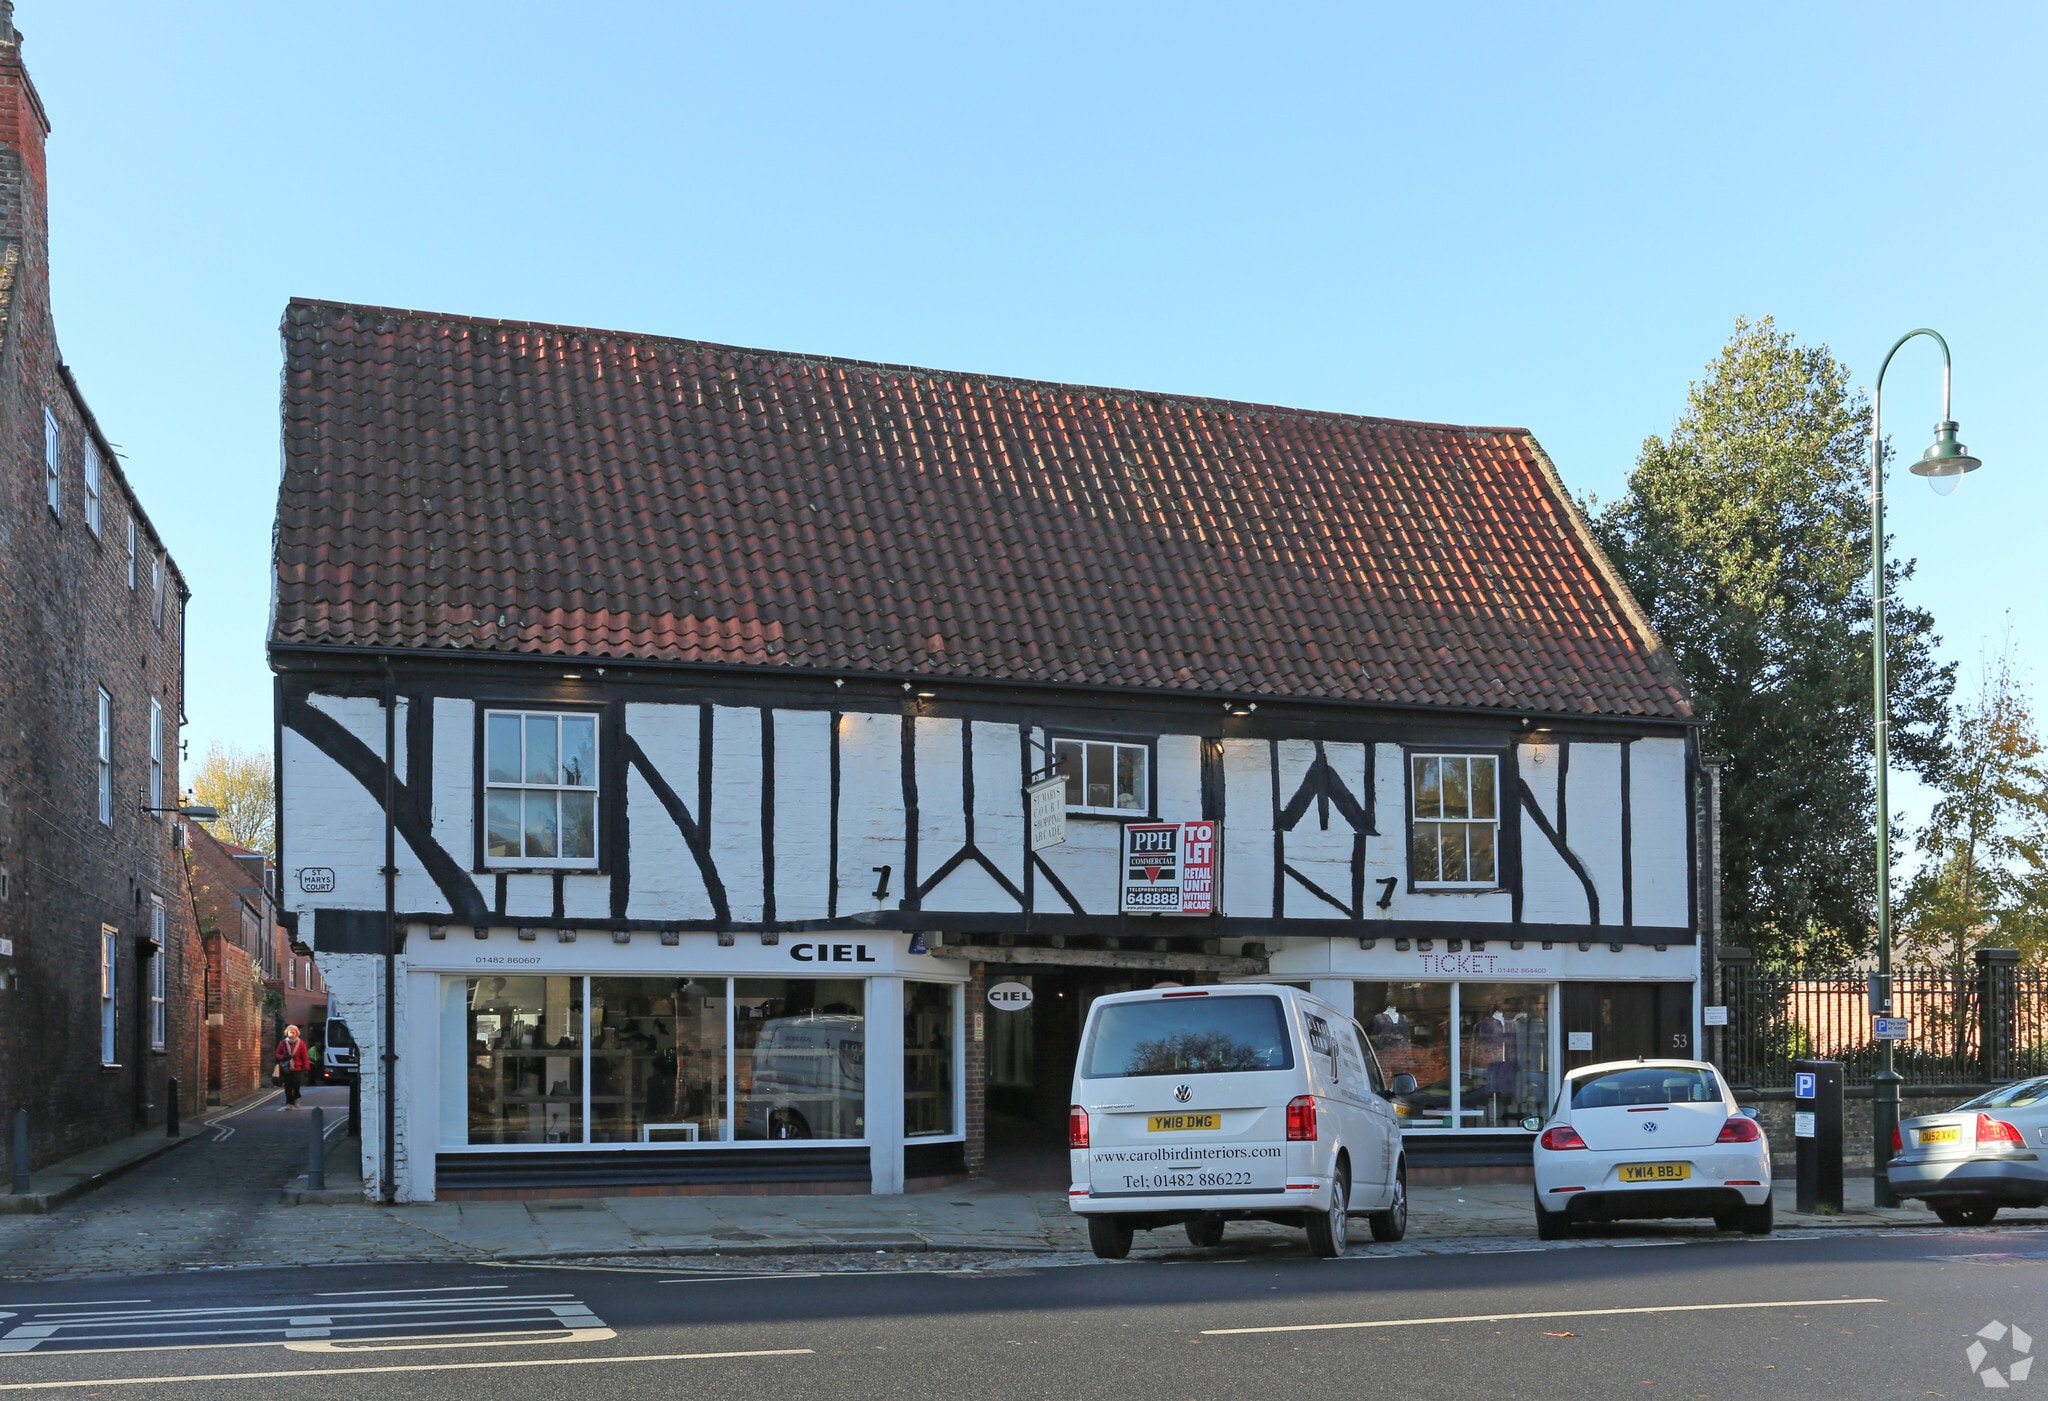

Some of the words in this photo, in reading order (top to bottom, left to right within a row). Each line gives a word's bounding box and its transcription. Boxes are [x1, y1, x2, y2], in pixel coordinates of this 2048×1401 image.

[1034, 799, 1061, 819] COURT
[1034, 825, 1062, 843] ARCADE
[1185, 826, 1212, 841] TO
[1134, 831, 1172, 851] PPH
[1185, 842, 1212, 864] LET
[1131, 857, 1175, 865] COMMERCIAL
[1184, 867, 1211, 880] RETAIL
[1183, 880, 1211, 892] UNIT
[1127, 893, 1178, 904] 648888
[1183, 892, 1211, 901] WITHIN
[1183, 901, 1211, 910] ARCADE
[789, 943, 876, 962] CIEL
[475, 956, 505, 964] 01482
[1419, 954, 1498, 973] TICKET
[989, 991, 1032, 1001] CIEL
[1672, 1034, 1688, 1048] 53
[1799, 1076, 1812, 1096] P
[1155, 1117, 1183, 1129] YW18
[1187, 1115, 1213, 1128] DWG
[1093, 1146, 1281, 1163] www.carolbirdinteriors.com
[1626, 1167, 1654, 1179] YW14
[1658, 1165, 1682, 1177] BBJ
[1153, 1174, 1195, 1187] 01482
[1198, 1172, 1252, 1186] 886222
